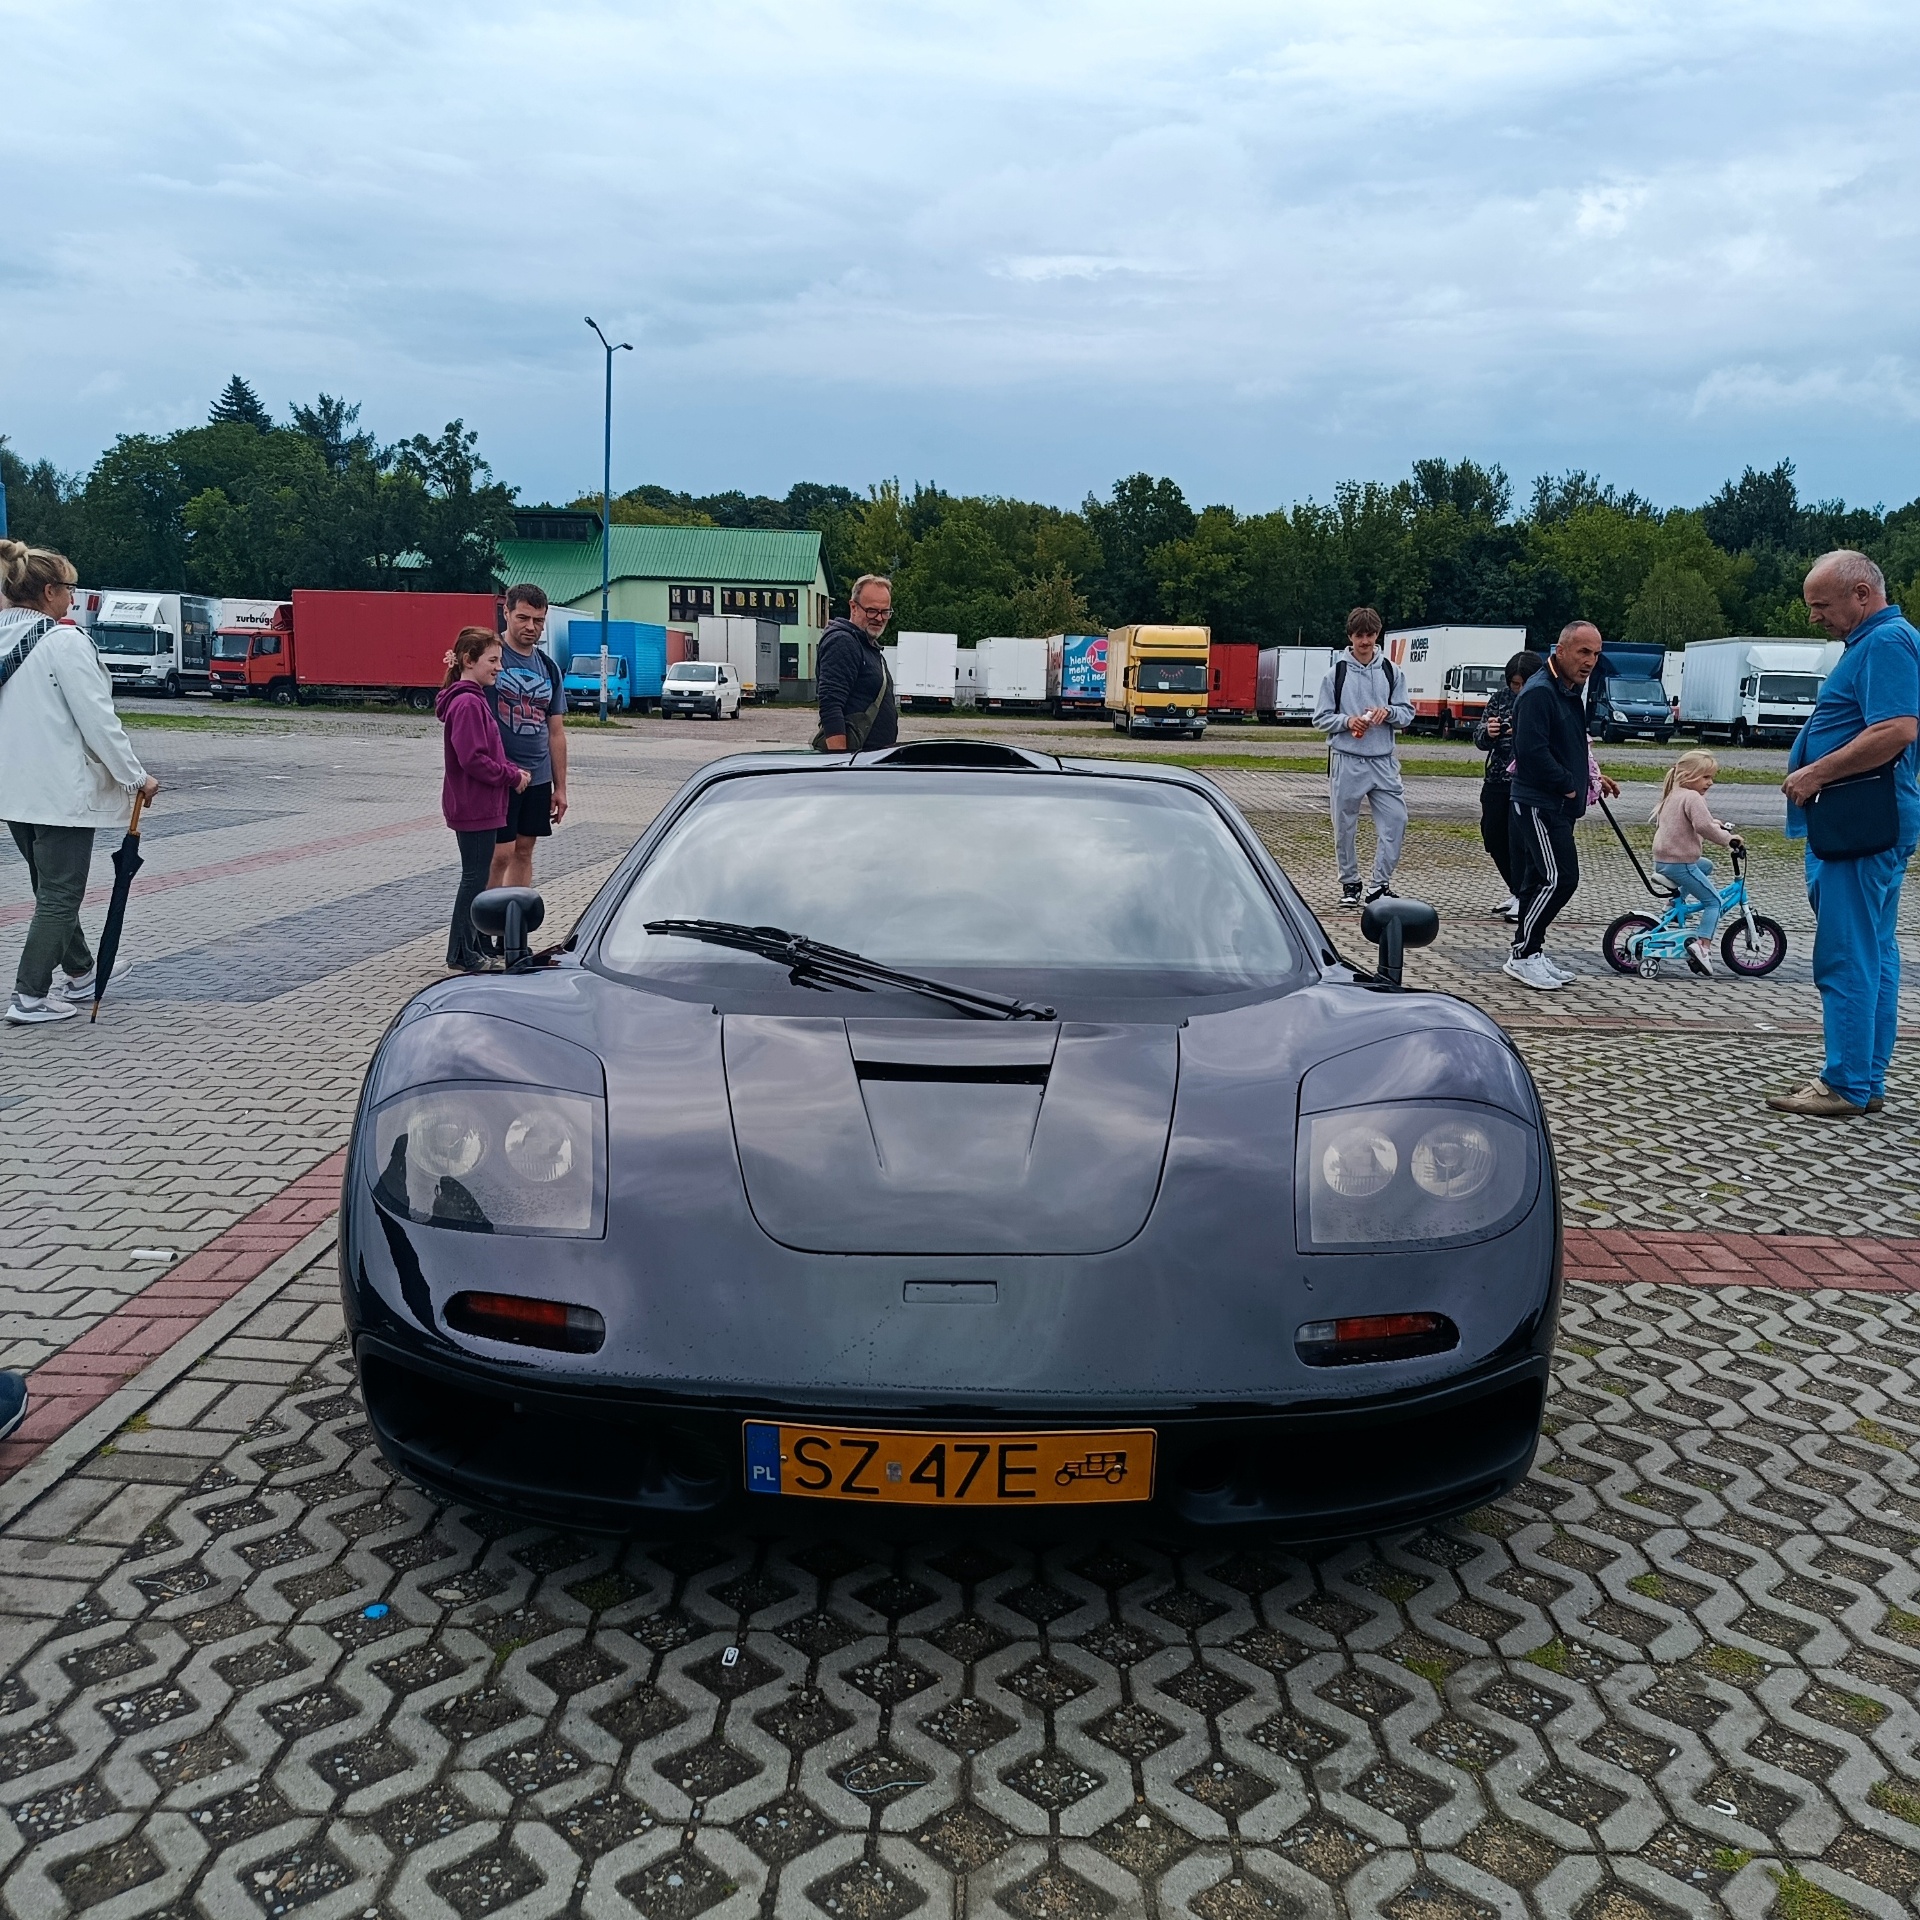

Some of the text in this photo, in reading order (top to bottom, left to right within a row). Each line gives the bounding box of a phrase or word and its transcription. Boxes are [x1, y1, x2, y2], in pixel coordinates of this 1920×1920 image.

[1410, 650, 1428, 662] KRAFT
[1069, 665, 1089, 675] mehr
[753, 1465, 776, 1482] PL
[794, 1436, 1038, 1498] SZ 47E
